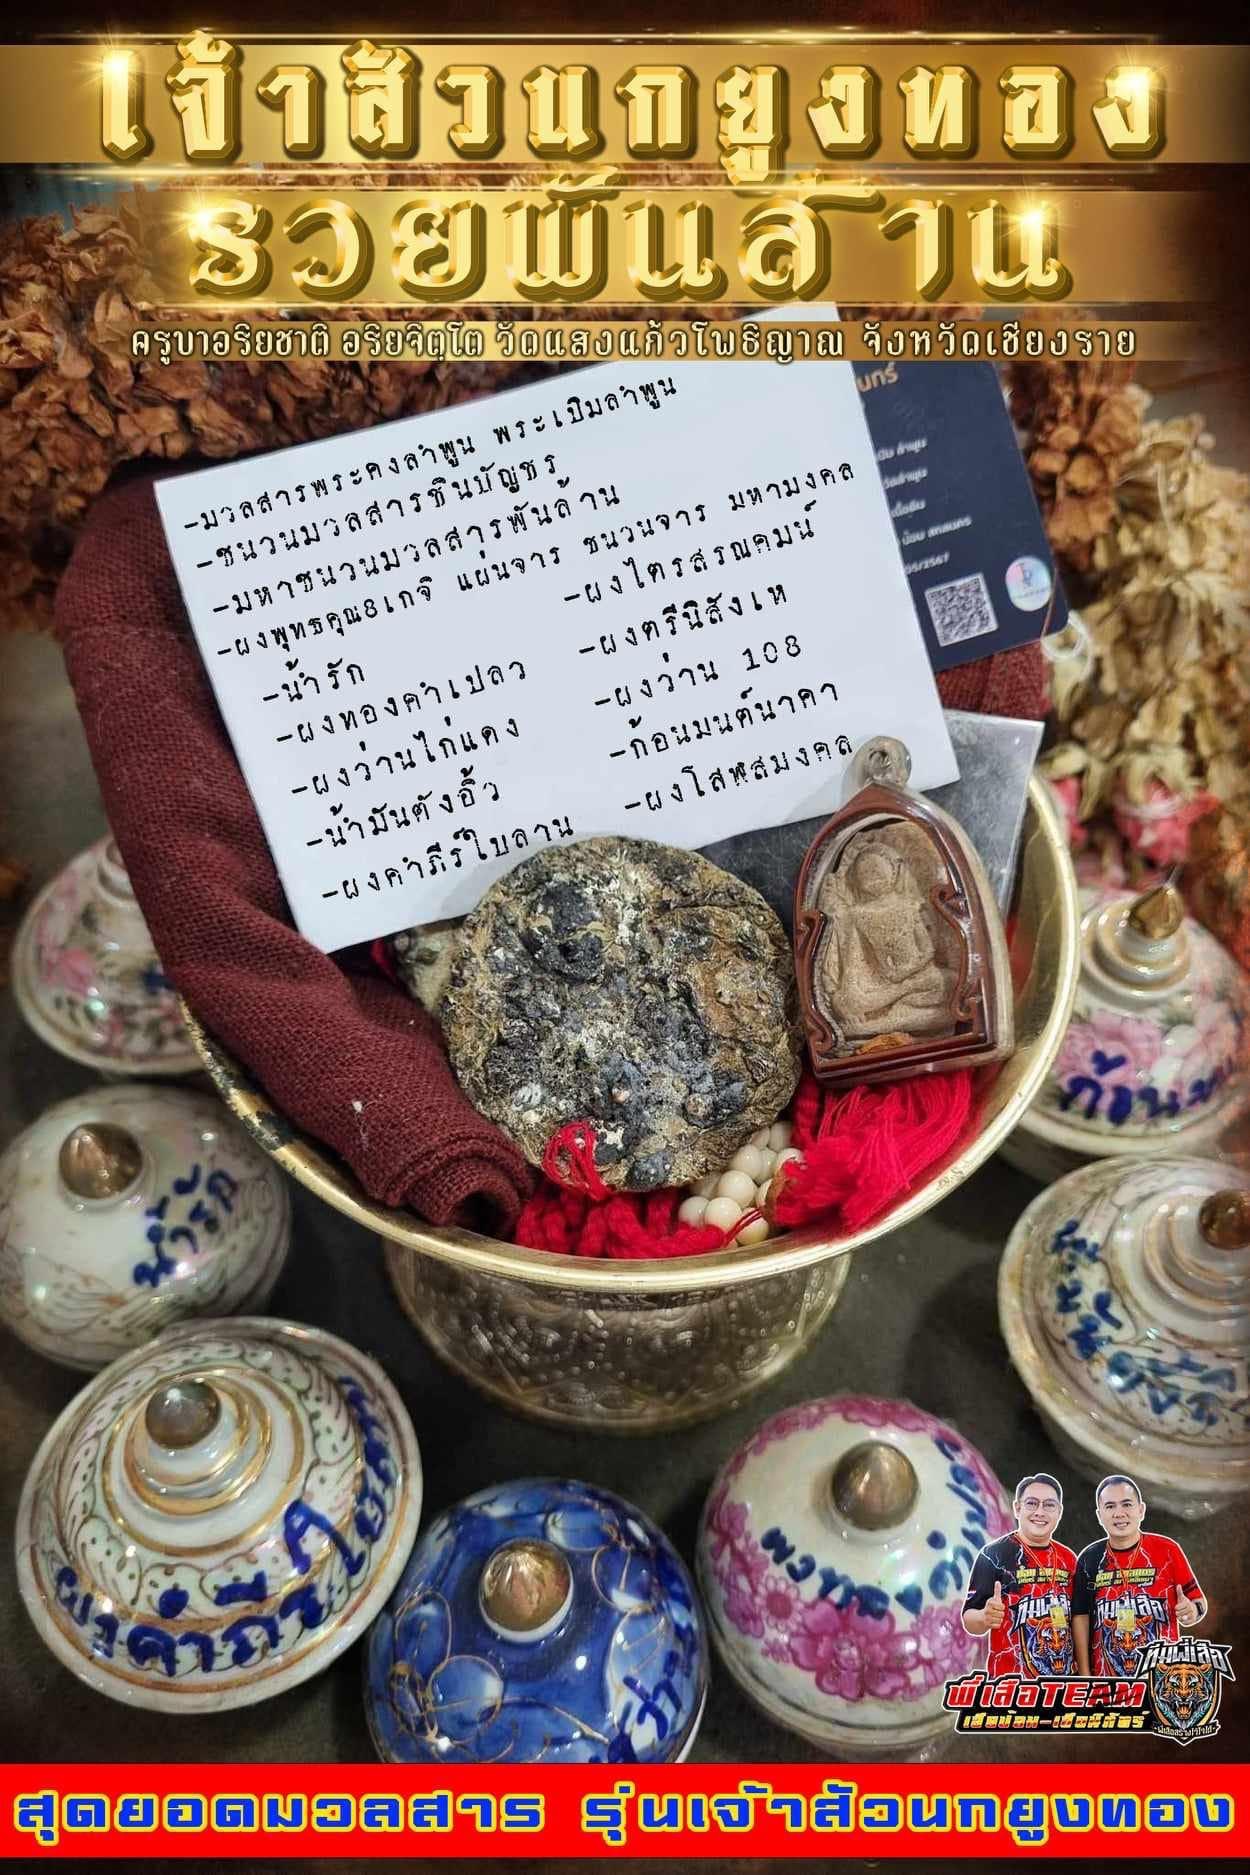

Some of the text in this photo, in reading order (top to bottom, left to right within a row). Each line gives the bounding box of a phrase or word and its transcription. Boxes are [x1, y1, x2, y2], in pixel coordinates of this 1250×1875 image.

[728, 462, 855, 512] มหามงคล
[742, 634, 802, 672] 108
